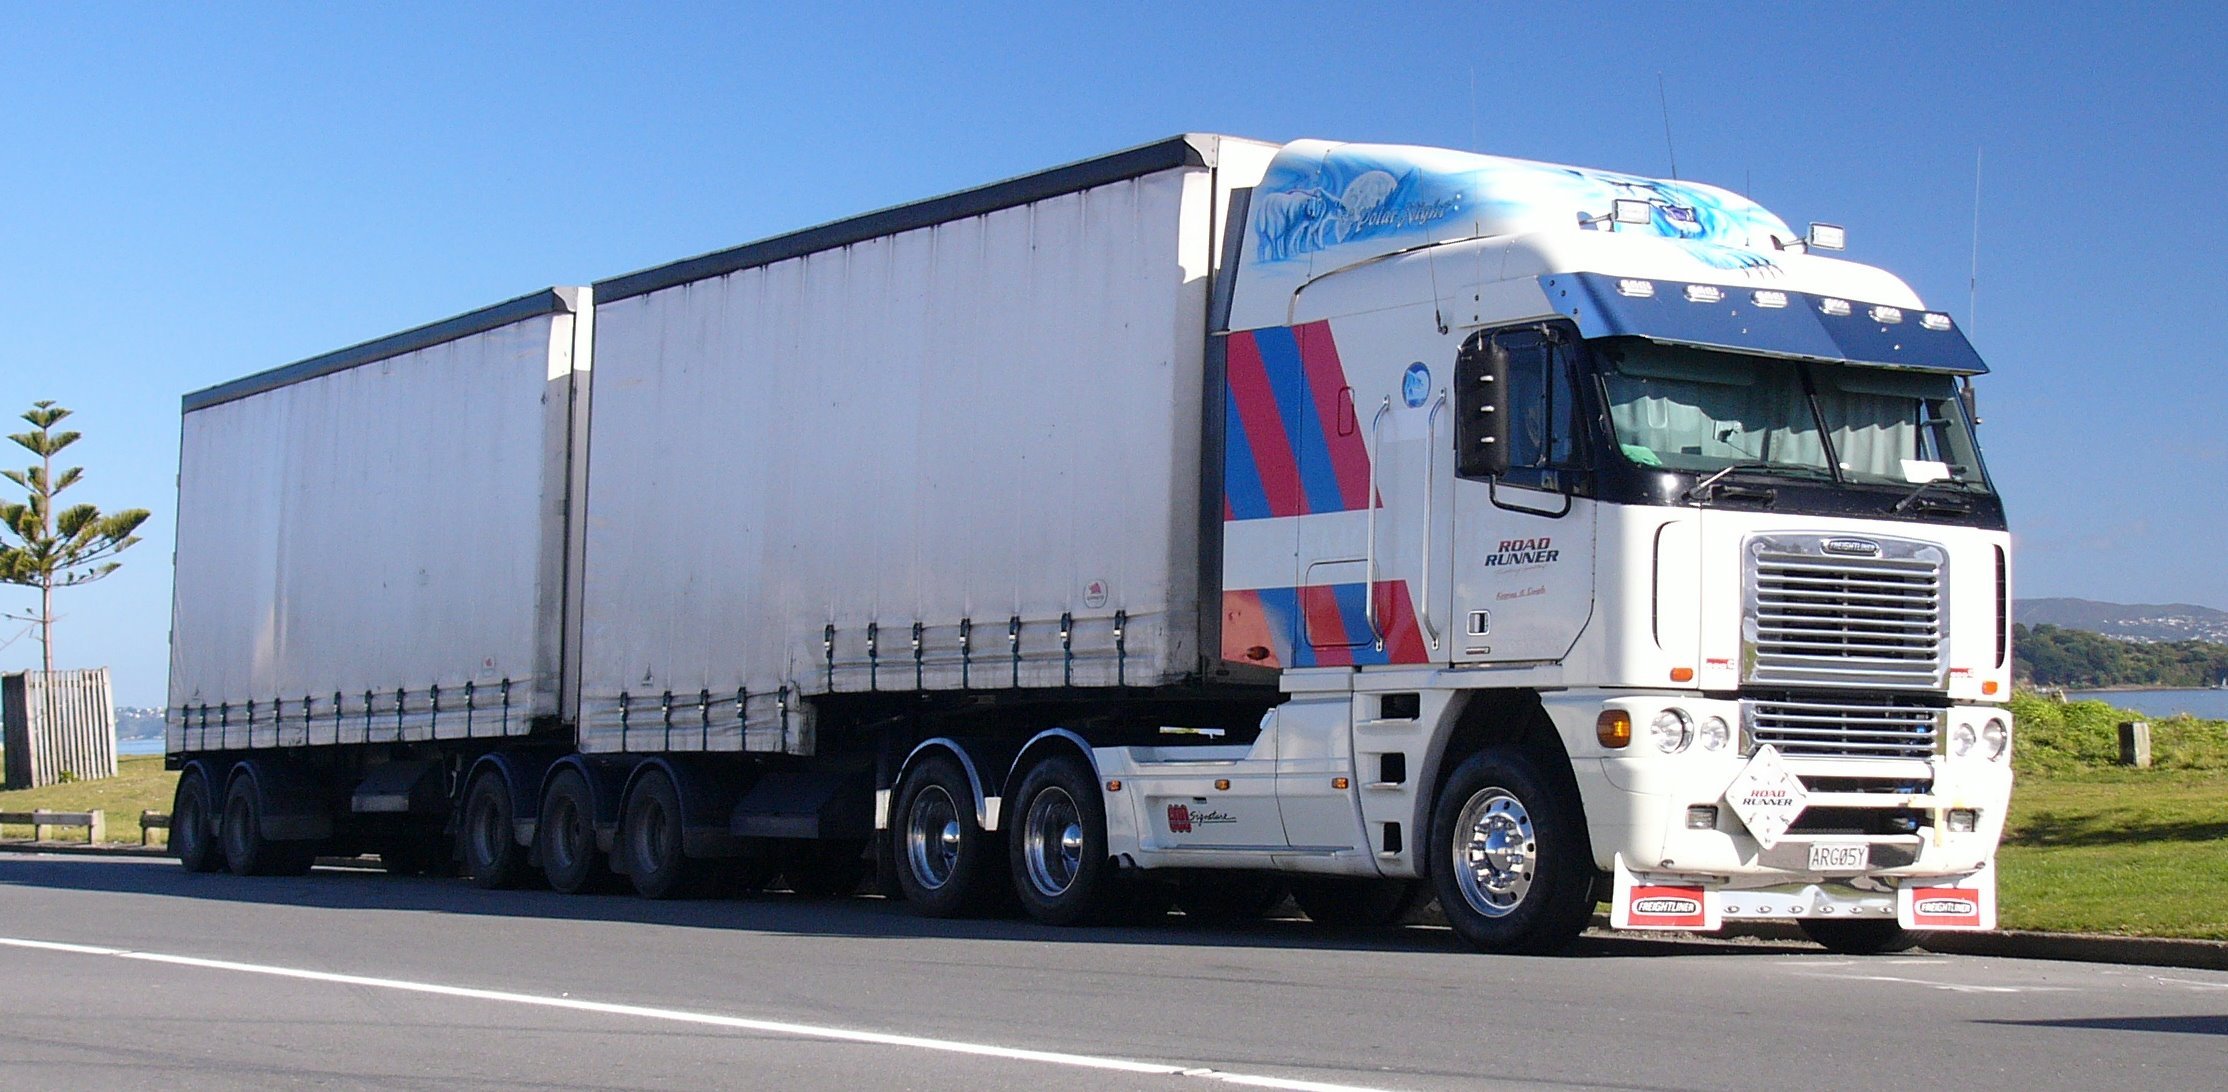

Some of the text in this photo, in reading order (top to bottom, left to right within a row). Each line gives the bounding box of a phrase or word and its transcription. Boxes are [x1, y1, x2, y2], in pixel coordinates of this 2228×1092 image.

[1355, 199, 1452, 232] Polar Night
[1498, 537, 1550, 553] ROAD
[1829, 541, 1876, 552] FREIGHTLINER
[1485, 550, 1559, 566] RUNNER
[1743, 798, 1792, 806] RUNNER
[1638, 901, 1695, 912] FREIGHTLINER
[1920, 902, 1971, 912] FREIGHTLINER
